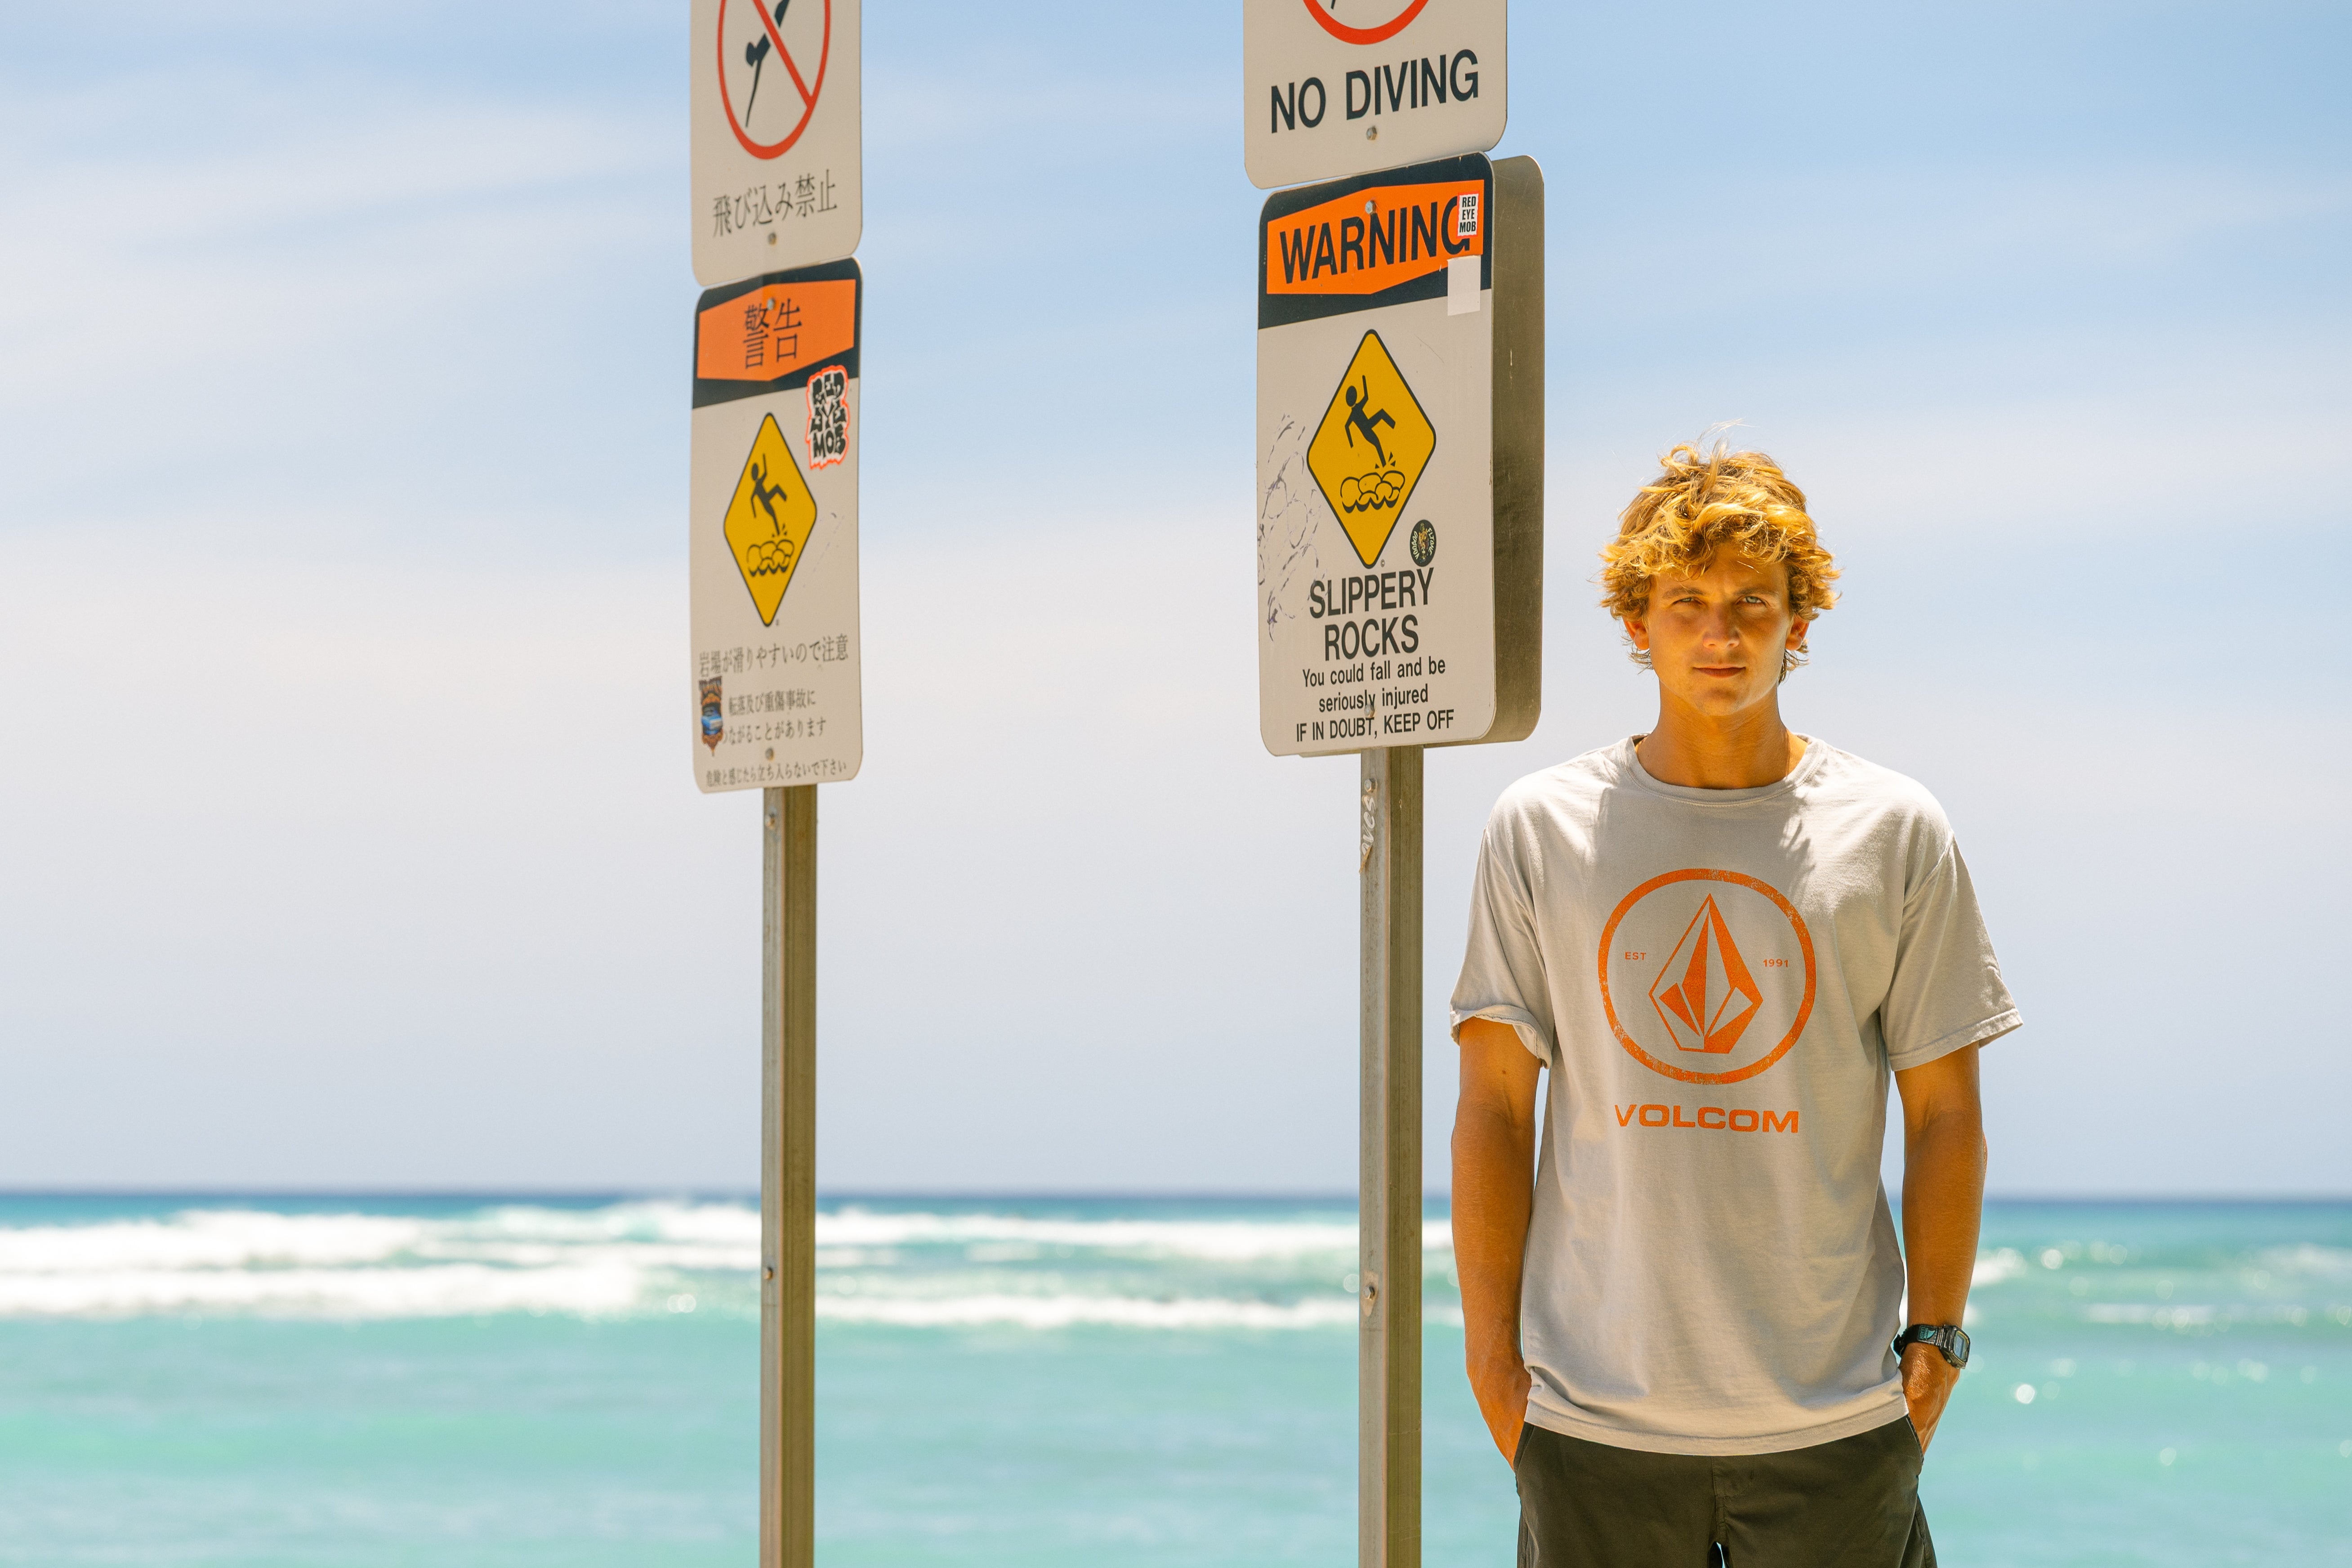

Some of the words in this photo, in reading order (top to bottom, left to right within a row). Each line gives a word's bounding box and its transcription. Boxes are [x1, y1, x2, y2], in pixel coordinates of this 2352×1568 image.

[1271, 77, 1326, 133] NO
[1346, 49, 1478, 120] DIVING
[713, 169, 838, 238] 飛び込み禁止
[1462, 196, 1477, 207] RED
[1462, 209, 1475, 220] EYE
[1279, 195, 1470, 284] WARNING
[1459, 221, 1477, 233] MOB
[742, 298, 803, 370] 警告
[813, 424, 846, 458] MOB
[1411, 531, 1420, 560] VOODOO
[1309, 567, 1435, 619] SLIPPERY
[1324, 614, 1419, 661] ROCKS
[699, 633, 848, 677] 岩場が滑りやすいので注意
[1302, 669, 1325, 687] You
[1330, 663, 1364, 685] could
[1370, 660, 1391, 681] fall
[1397, 657, 1422, 678] and
[1428, 656, 1446, 675] be
[1319, 689, 1376, 713] seriously
[1382, 683, 1428, 710] injured
[1297, 723, 1307, 742] IF
[1312, 721, 1324, 741] IN
[1330, 717, 1378, 739] DOUBT,
[1384, 712, 1421, 734] KEEP
[1427, 709, 1454, 730] OFF
[1625, 952, 1647, 960] EST
[1763, 959, 1789, 967] 1991
[1615, 1104, 1799, 1133] VOLCOM
